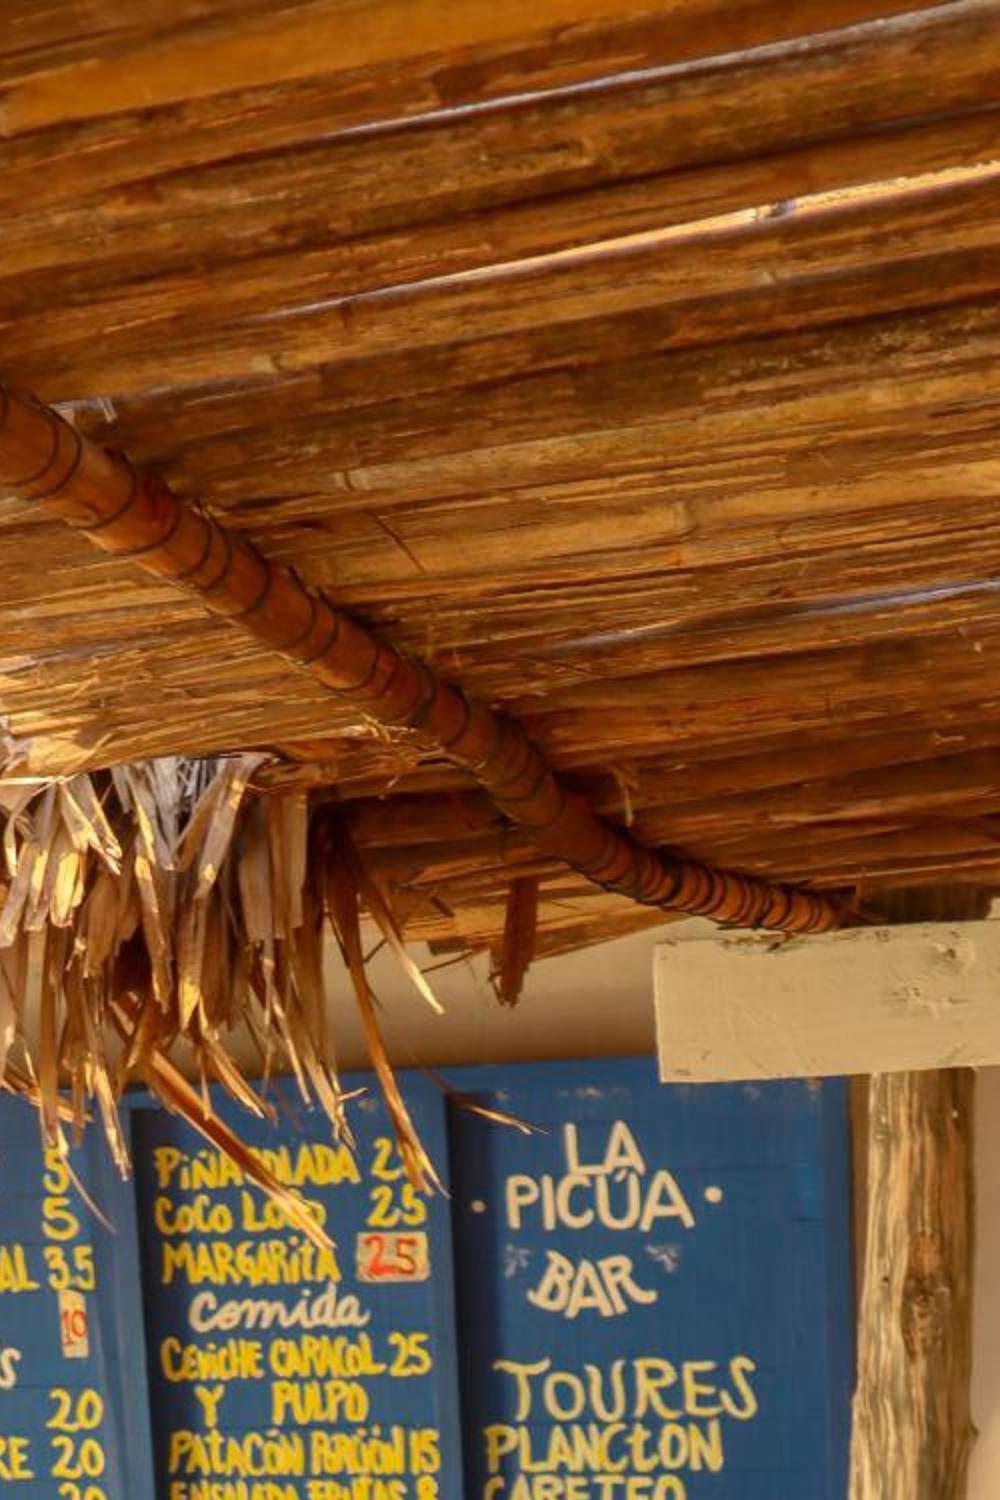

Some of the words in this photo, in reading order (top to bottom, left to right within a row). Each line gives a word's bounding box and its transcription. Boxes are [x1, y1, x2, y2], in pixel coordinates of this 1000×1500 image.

[43, 1147, 71, 1195] 5
[370, 1136, 408, 1183] 2
[564, 1120, 647, 1176] LA
[41, 1197, 81, 1241] 5
[366, 1183, 428, 1228] 25
[505, 1168, 697, 1232] PICÚA
[363, 1235, 417, 1277] 25
[188, 1281, 372, 1333] Comida
[527, 1249, 659, 1320] BAR
[62, 1309, 89, 1345] 10
[269, 1332, 388, 1379] CARACOL
[387, 1331, 433, 1378] 25
[46, 1388, 104, 1430] 20
[193, 1383, 225, 1428] Y
[271, 1379, 370, 1426] PULPO
[492, 1355, 759, 1423] TOURES
[51, 1437, 106, 1479] 20
[409, 1427, 441, 1476] 15
